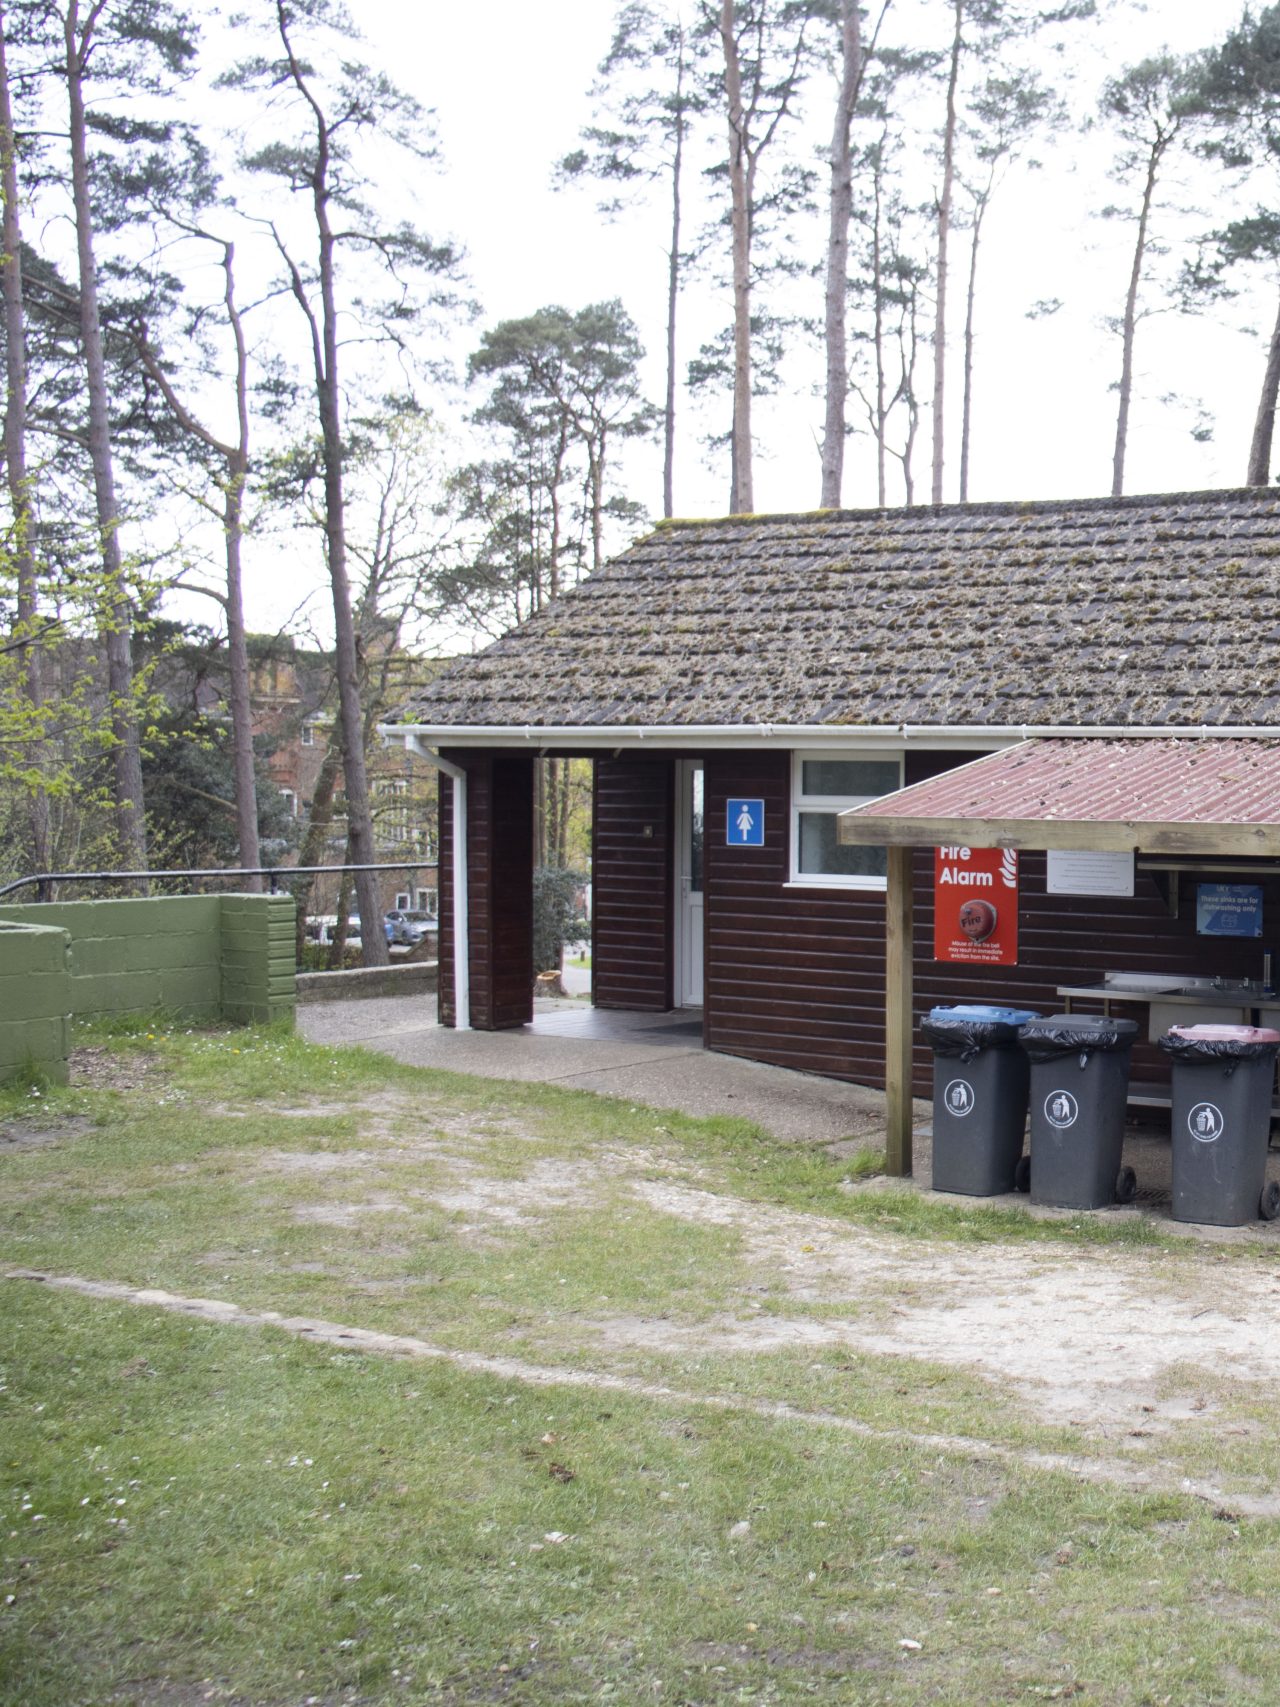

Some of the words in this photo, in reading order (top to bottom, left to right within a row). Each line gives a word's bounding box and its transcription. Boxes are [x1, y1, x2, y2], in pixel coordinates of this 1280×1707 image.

[940, 846, 972, 861] Fire
[939, 867, 993, 886] Alarm
[1201, 895, 1218, 903] These
[1220, 896, 1236, 904] sinks
[1249, 896, 1258, 905] for
[1202, 903, 1241, 913] dishwashing
[1242, 904, 1256, 913] only
[961, 915, 981, 928] Fire
